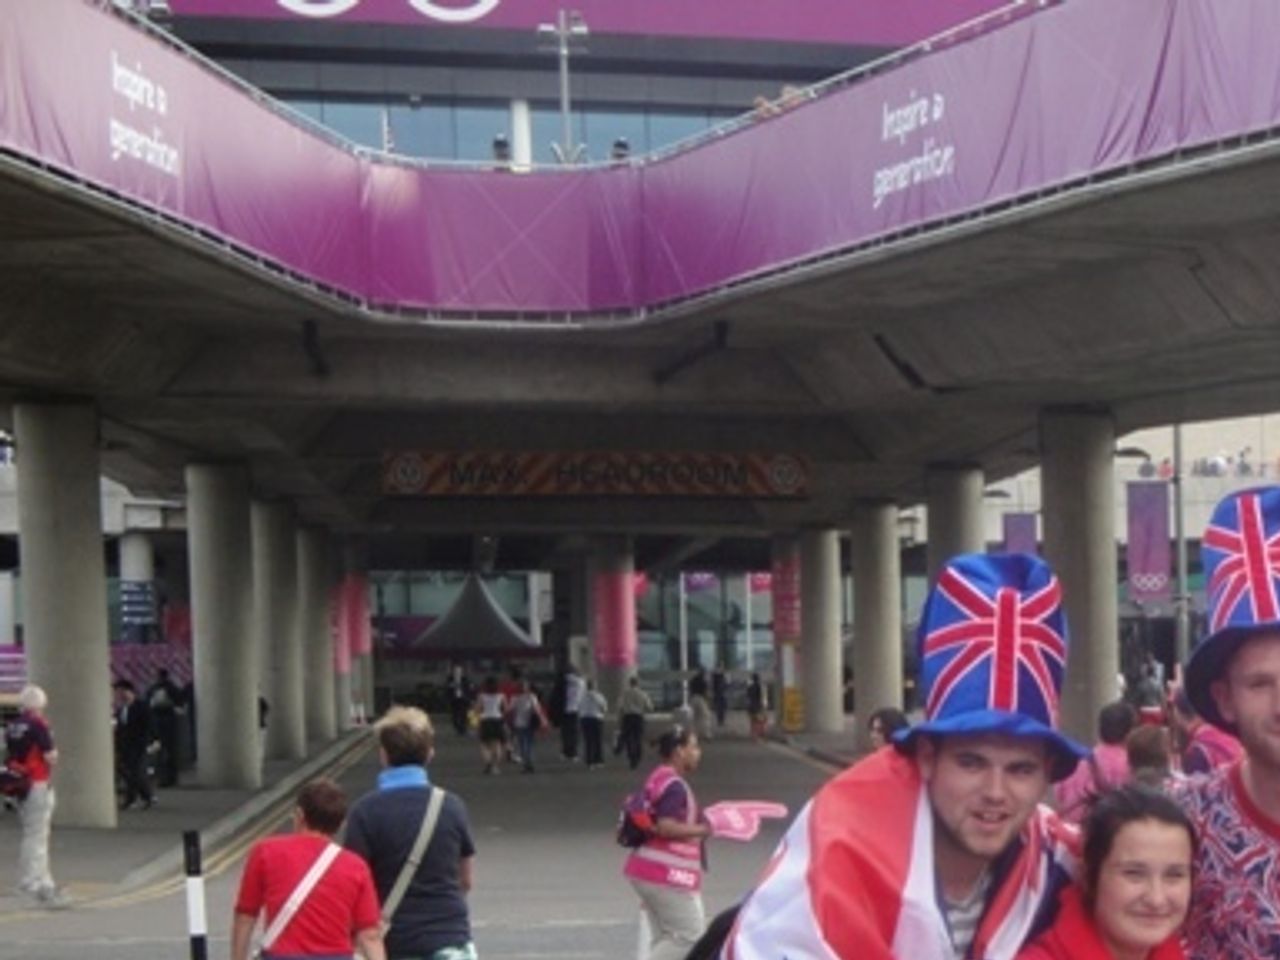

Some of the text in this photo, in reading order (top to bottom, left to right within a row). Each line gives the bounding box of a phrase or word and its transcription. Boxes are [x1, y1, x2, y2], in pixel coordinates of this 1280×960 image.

[111, 51, 167, 115] Inspire a
[110, 118, 182, 176] generation
[882, 90, 944, 146] Inspire a
[873, 137, 955, 209] generation
[555, 460, 749, 486] HEADROOM
